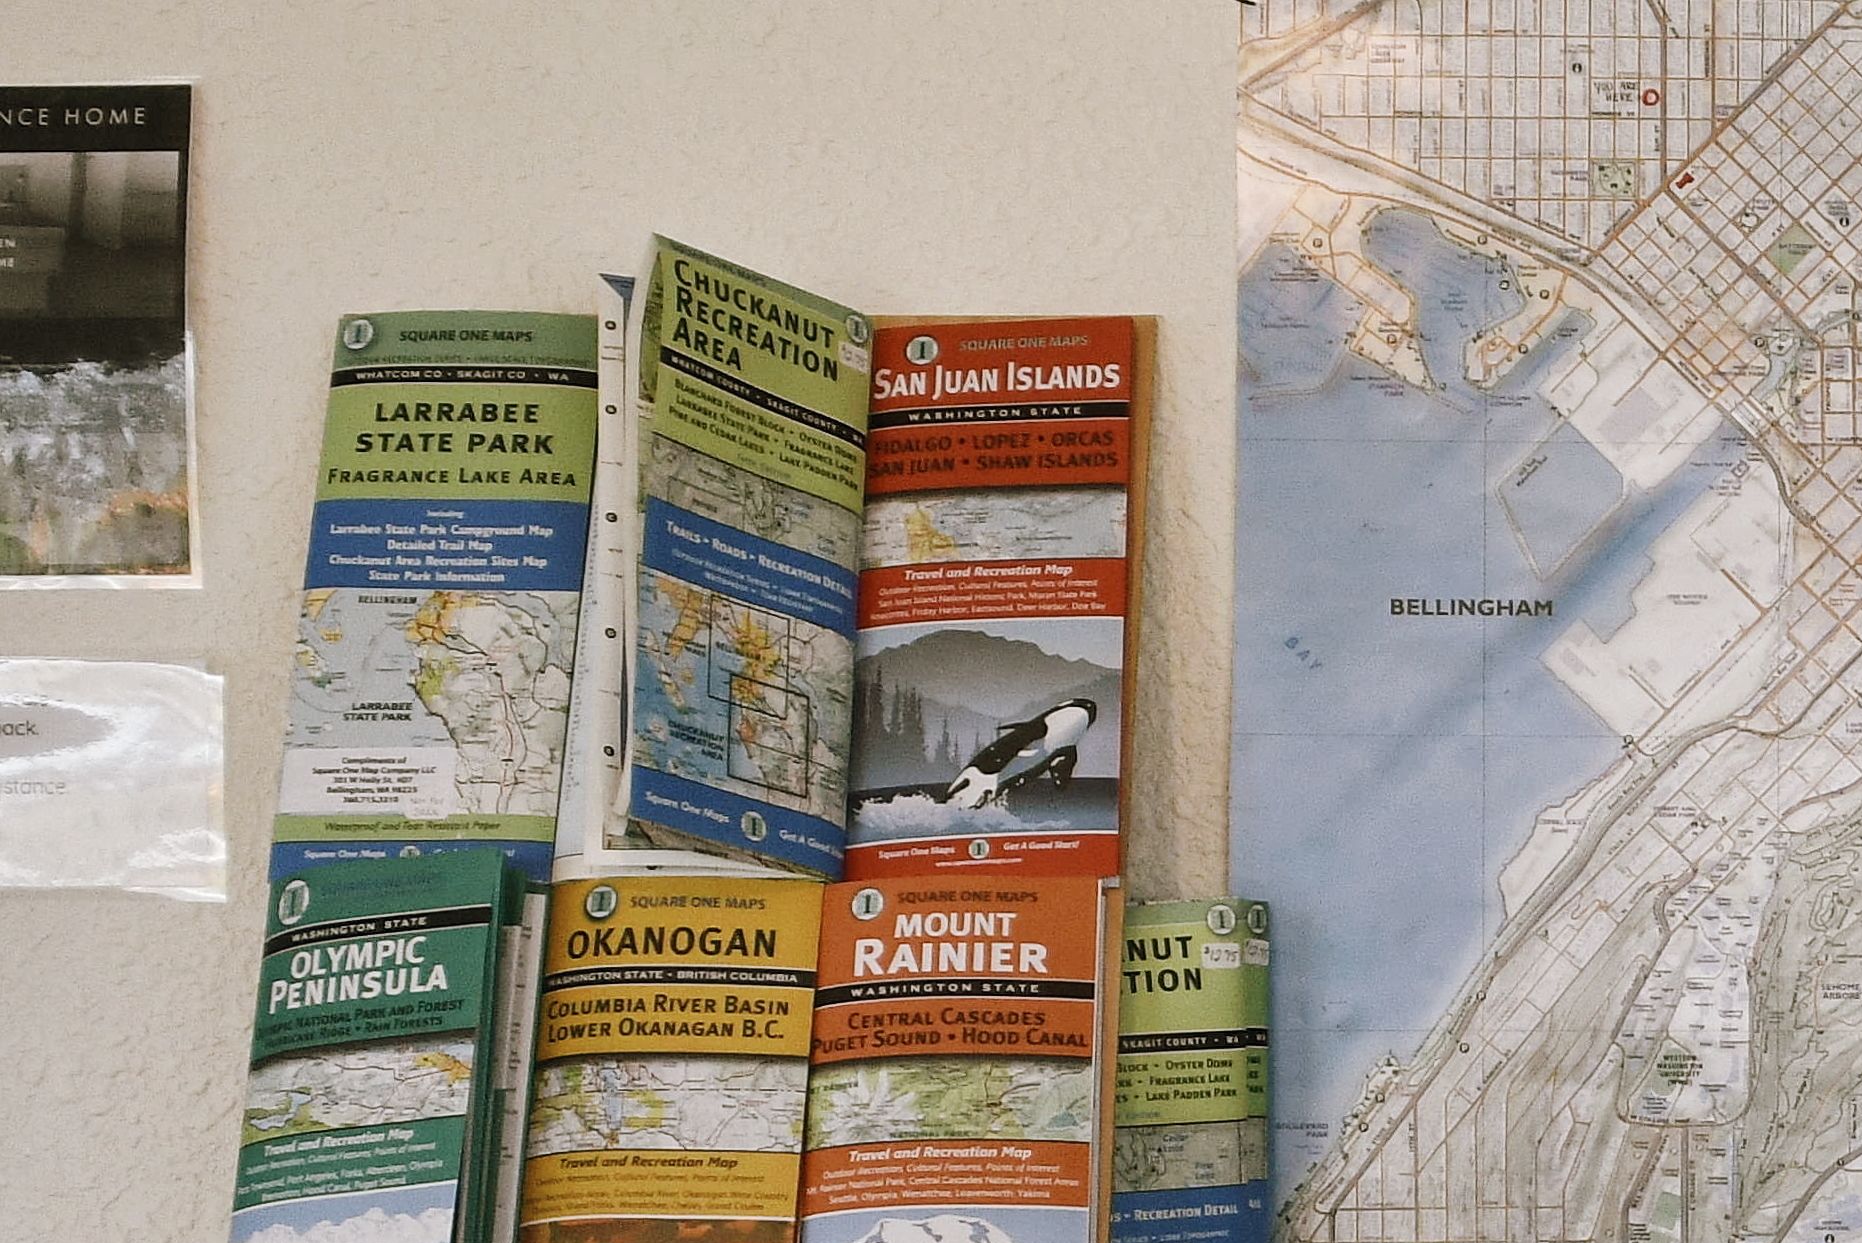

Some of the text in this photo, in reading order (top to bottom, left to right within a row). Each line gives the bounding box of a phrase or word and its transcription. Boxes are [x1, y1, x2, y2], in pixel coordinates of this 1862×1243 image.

[64, 107, 146, 125] HOME
[673, 259, 835, 348] CHUCKANUT
[672, 317, 742, 371] AREA
[675, 285, 838, 382] RECREATION
[874, 361, 1121, 400] SAN JUAN ISLANDS
[375, 402, 540, 423] LARRABEE
[908, 406, 1082, 422] WASHINGTON STATE
[355, 432, 554, 455] STATE PARK
[328, 468, 576, 486] FRAGRANCE LAKE AREA
[1044, 564, 1073, 576] Map
[1390, 598, 1553, 617] BELLINGHAM
[894, 911, 1017, 938] MOUNT
[568, 926, 776, 960] OKANOGAN
[290, 936, 427, 979] OLYMPIC
[853, 938, 1048, 977] RAINIER
[268, 964, 448, 1015] PENINSULA
[851, 983, 1040, 997] WASHINGTON STATE
[548, 994, 789, 1019] COLUMBIA RIVER BASIN
[848, 1008, 1046, 1029] CENTRAL CASCADES
[548, 1018, 784, 1043] LOWER OKANAGAN B.C.
